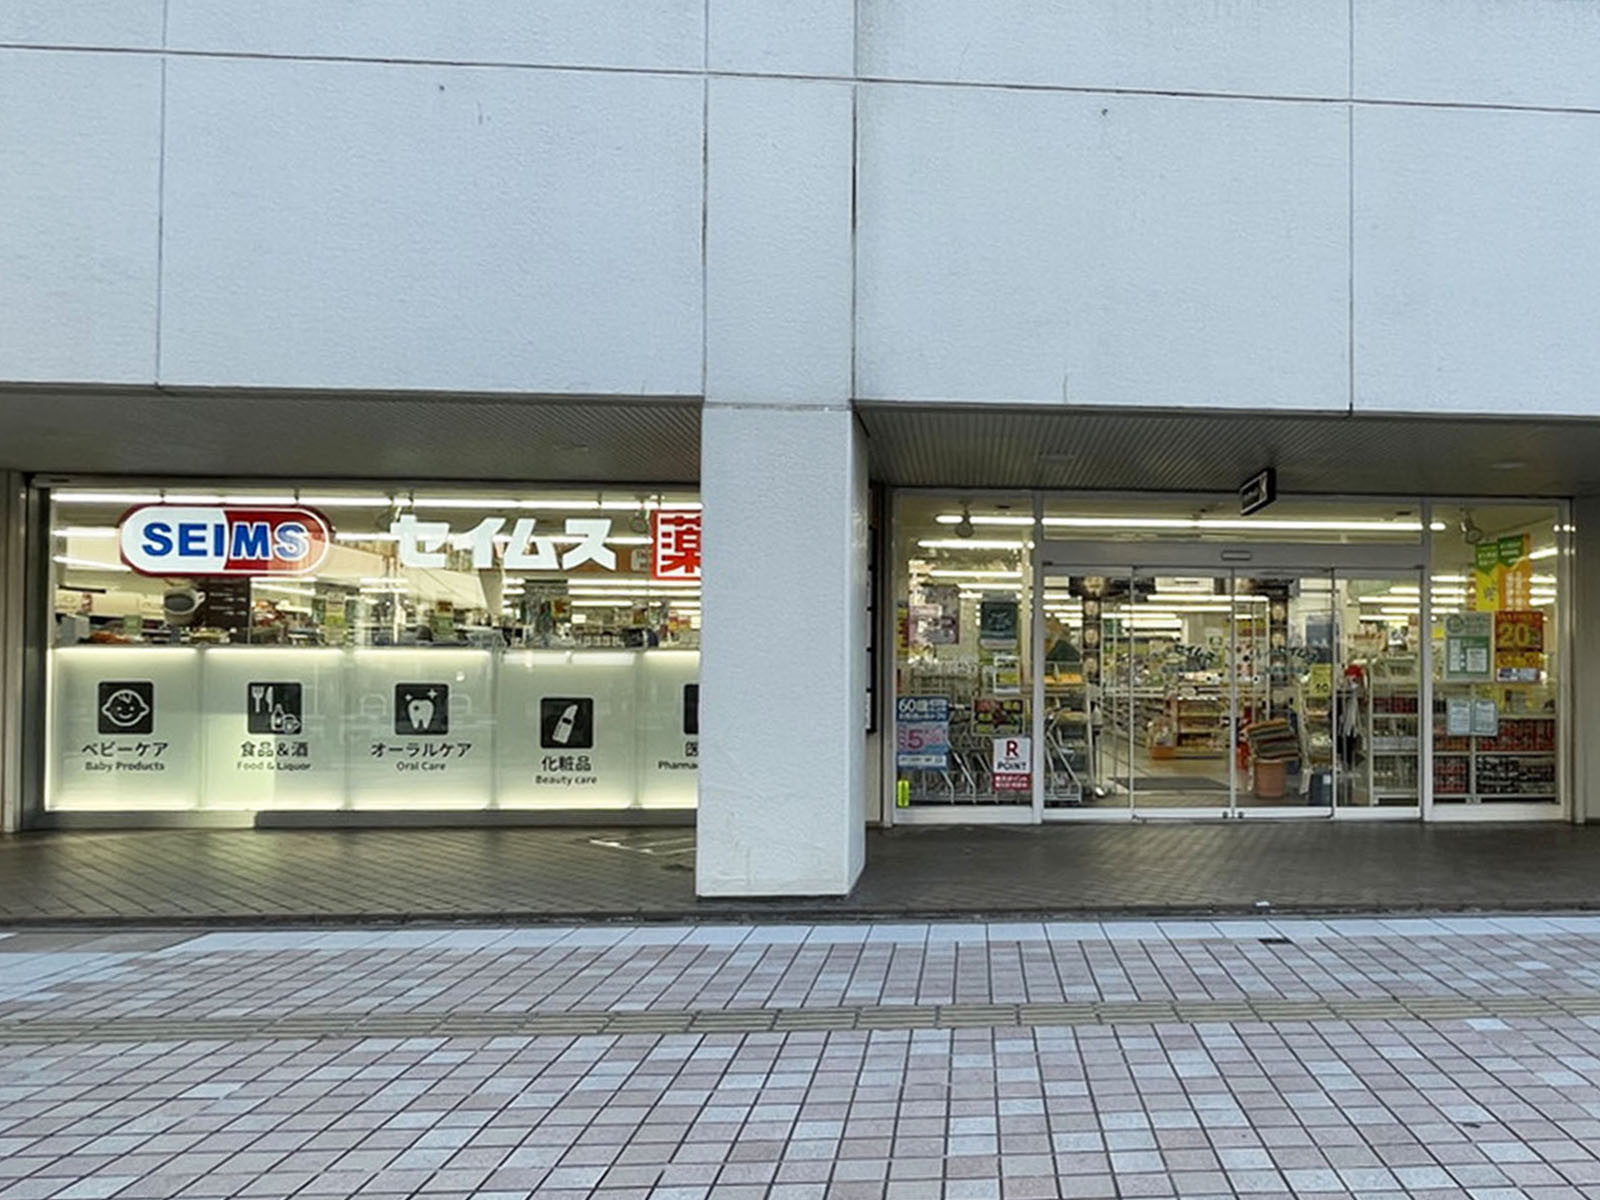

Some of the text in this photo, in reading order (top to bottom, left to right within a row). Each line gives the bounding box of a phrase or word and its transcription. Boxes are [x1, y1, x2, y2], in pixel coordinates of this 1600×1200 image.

[142, 521, 309, 560] SEIMS
[390, 514, 617, 571] セイムス
[660, 514, 702, 574] 薬
[81, 741, 169, 757] ベビーケア
[240, 741, 309, 757] 食品&酒
[370, 742, 472, 758] オーラルケア
[1006, 740, 1019, 757] R
[85, 761, 165, 773] Baby Products
[236, 761, 311, 773] Food & Liquor
[396, 761, 446, 771] Oral Care
[541, 755, 592, 772] 化粧品
[997, 761, 1027, 770] POINT
[535, 774, 597, 786] Beauty care
